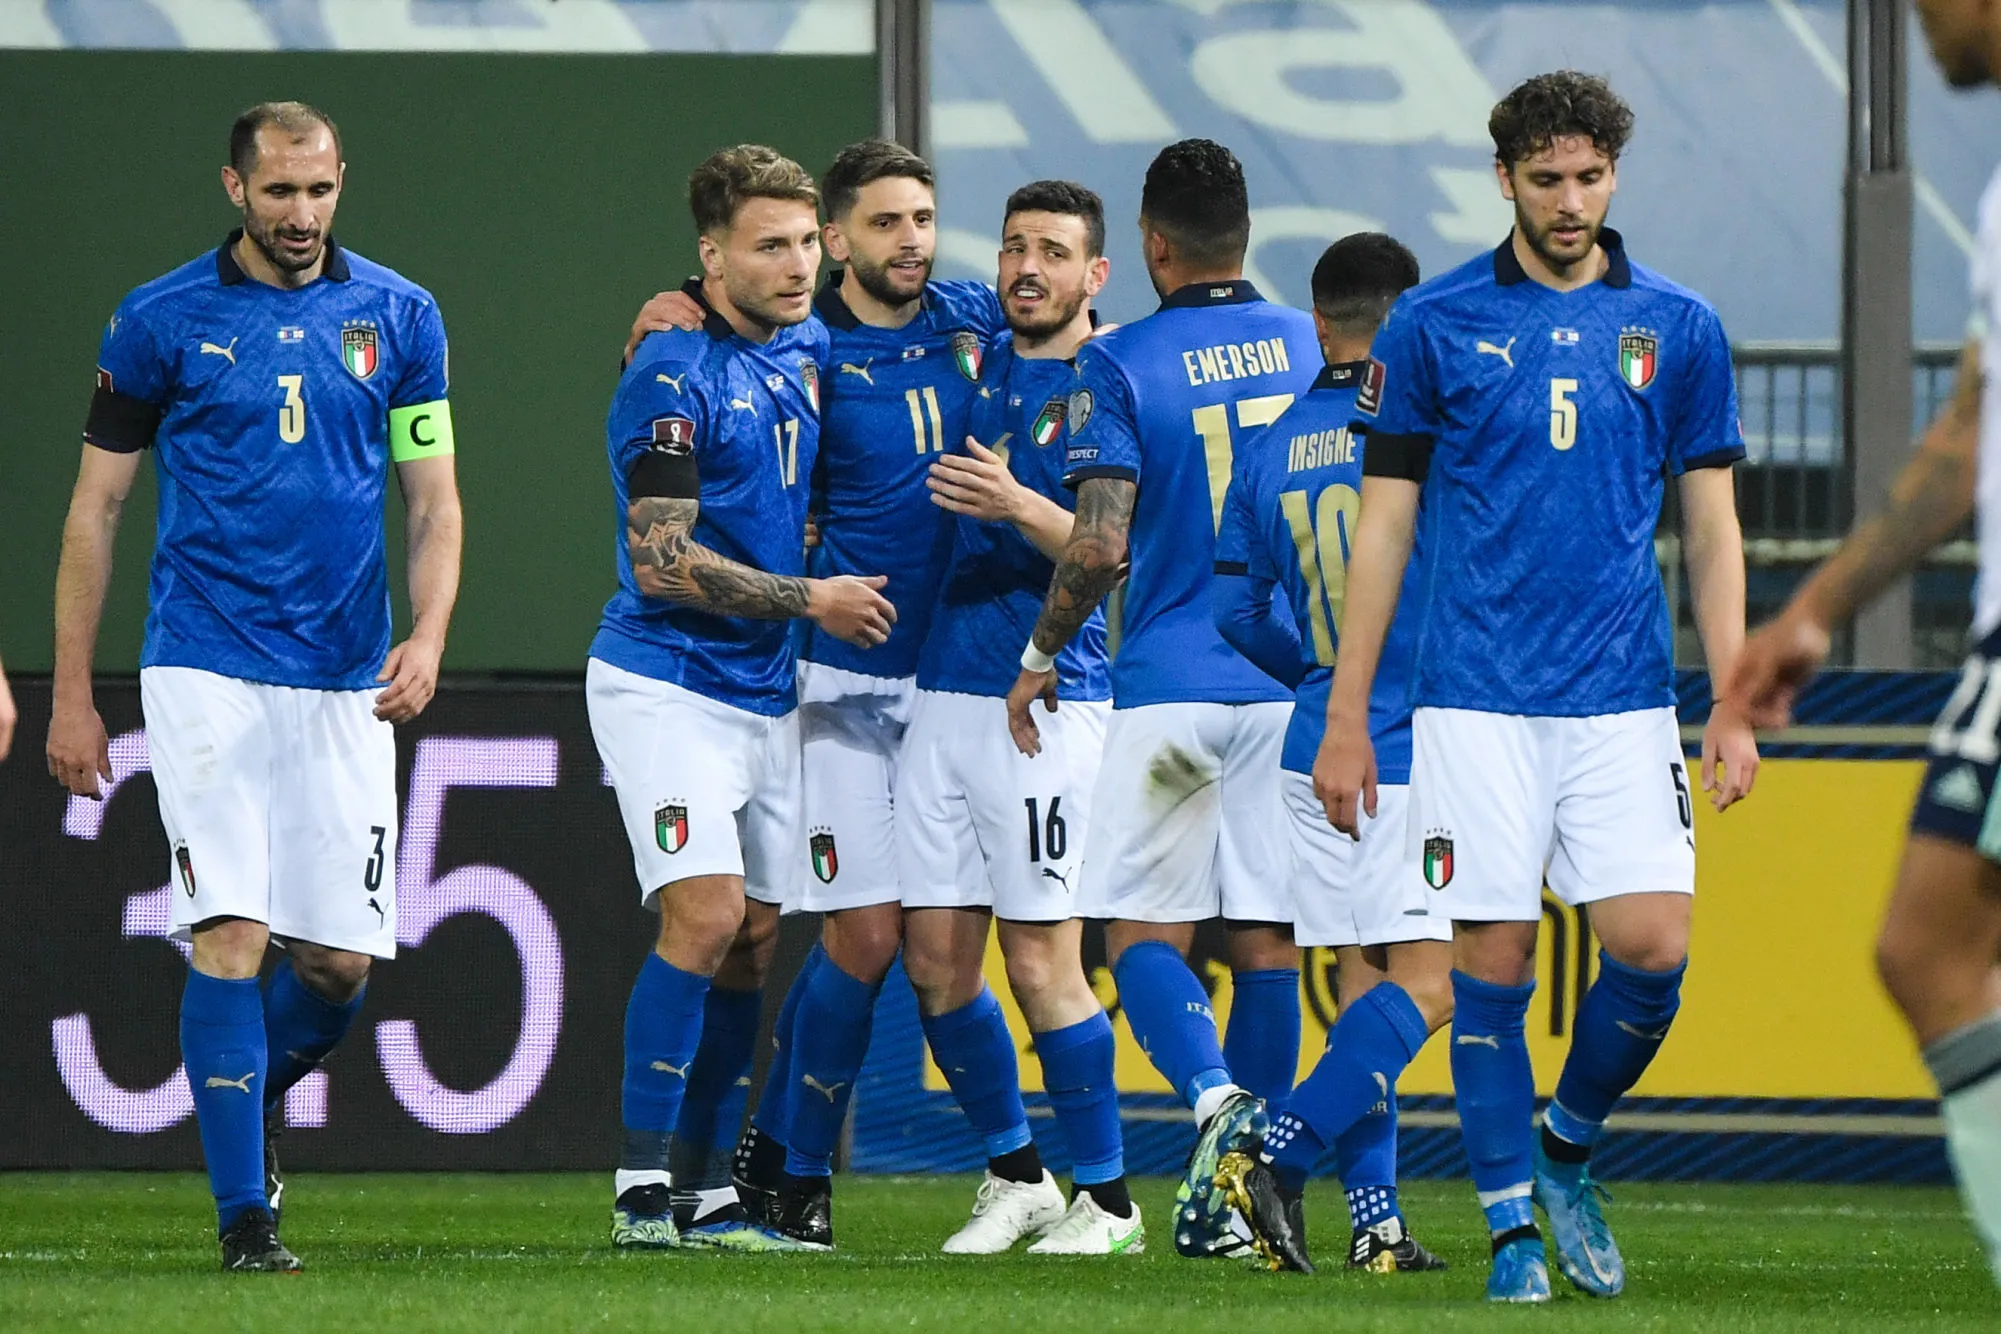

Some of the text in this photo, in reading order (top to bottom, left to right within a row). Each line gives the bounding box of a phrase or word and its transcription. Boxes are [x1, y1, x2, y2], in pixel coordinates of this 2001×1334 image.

[344, 332, 374, 341] ITALIA
[1182, 337, 1290, 386] EMERSON
[277, 375, 305, 444] 3
[409, 414, 436, 446] C
[905, 386, 944, 454] 11
[1550, 378, 1578, 451] 5
[774, 417, 799, 490] 17
[1287, 426, 1356, 473] INSIGNE
[1279, 483, 1360, 667] 10
[656, 808, 685, 820] ITALIA
[1024, 796, 1067, 862] 16
[1669, 762, 1692, 829] 5
[364, 825, 386, 892] 3
